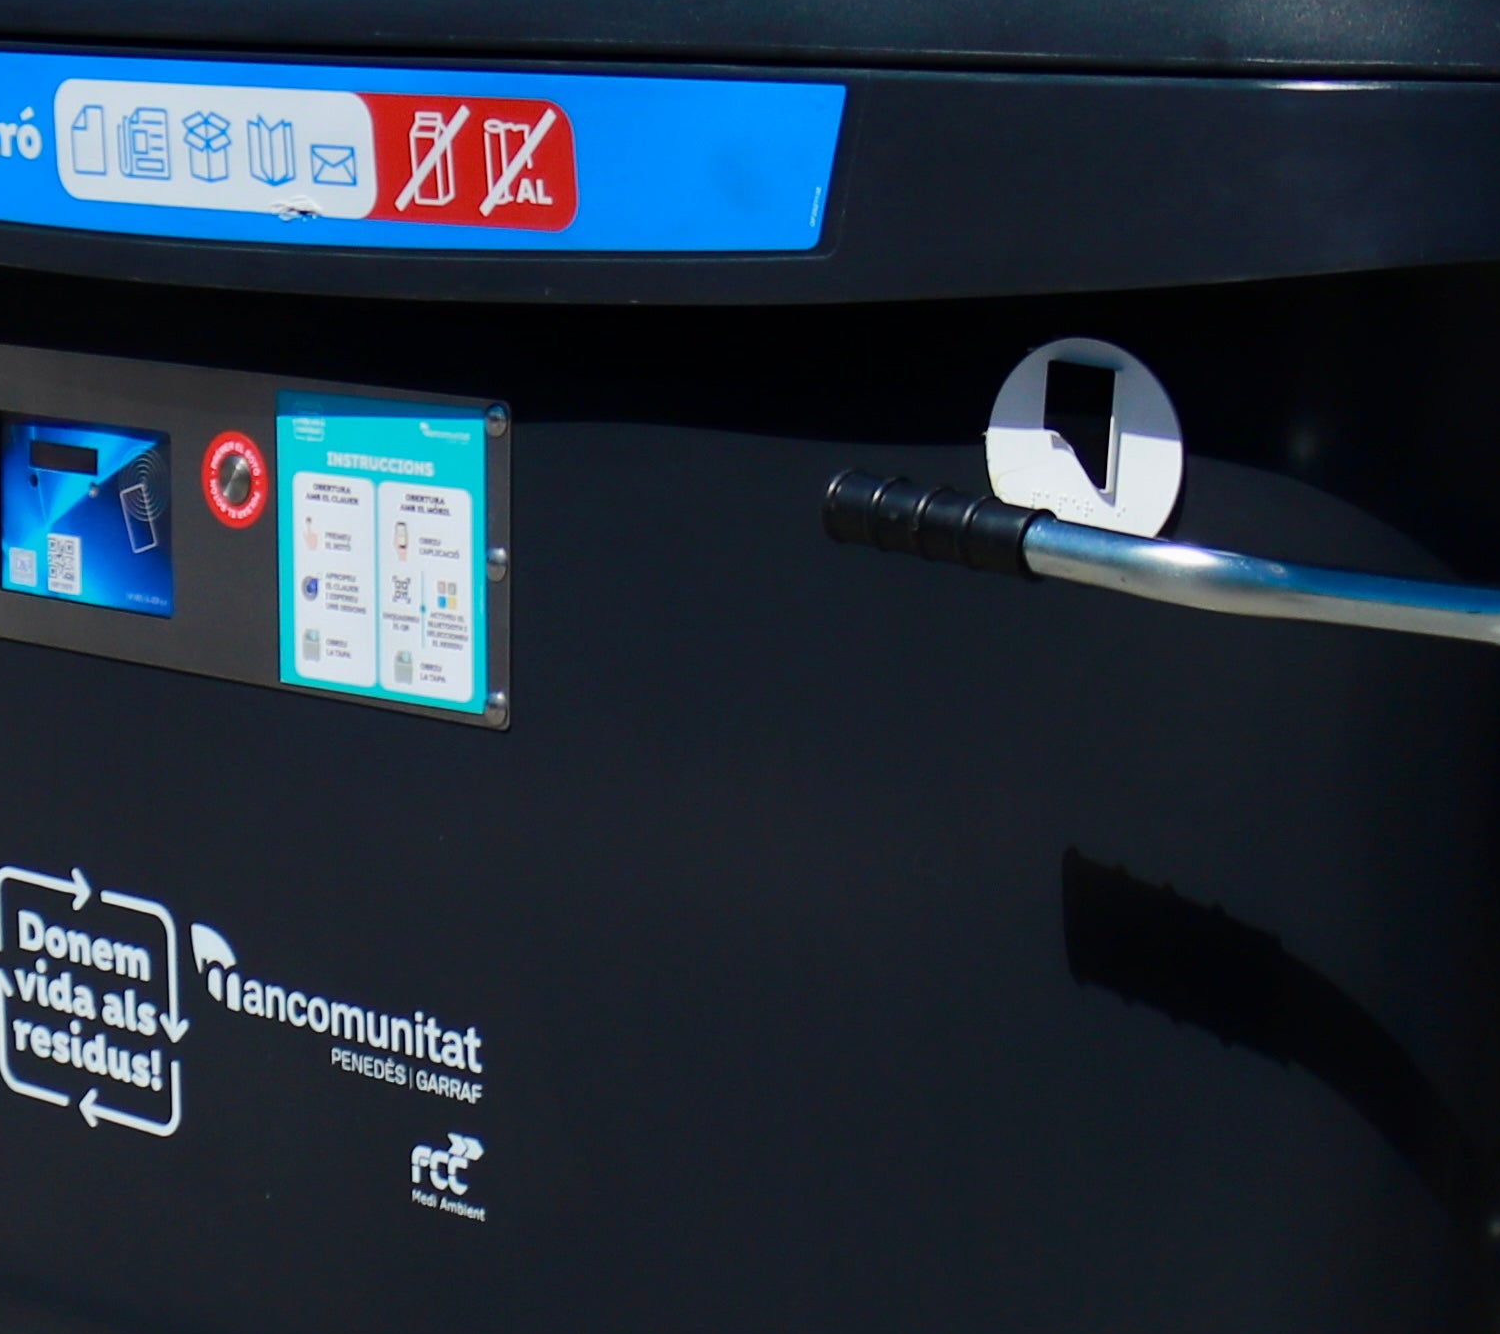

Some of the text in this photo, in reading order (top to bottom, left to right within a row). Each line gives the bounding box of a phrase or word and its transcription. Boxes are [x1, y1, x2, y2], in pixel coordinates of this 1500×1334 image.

[516, 178, 553, 205] AL
[327, 451, 435, 477] INSTRUCCIONS
[17, 908, 152, 982] Donem
[14, 960, 157, 1037] vida als
[12, 1016, 164, 1091] residus!
[330, 1046, 484, 1105] PENEDÈS GARRAF
[411, 1189, 486, 1222] Medi Ambient
